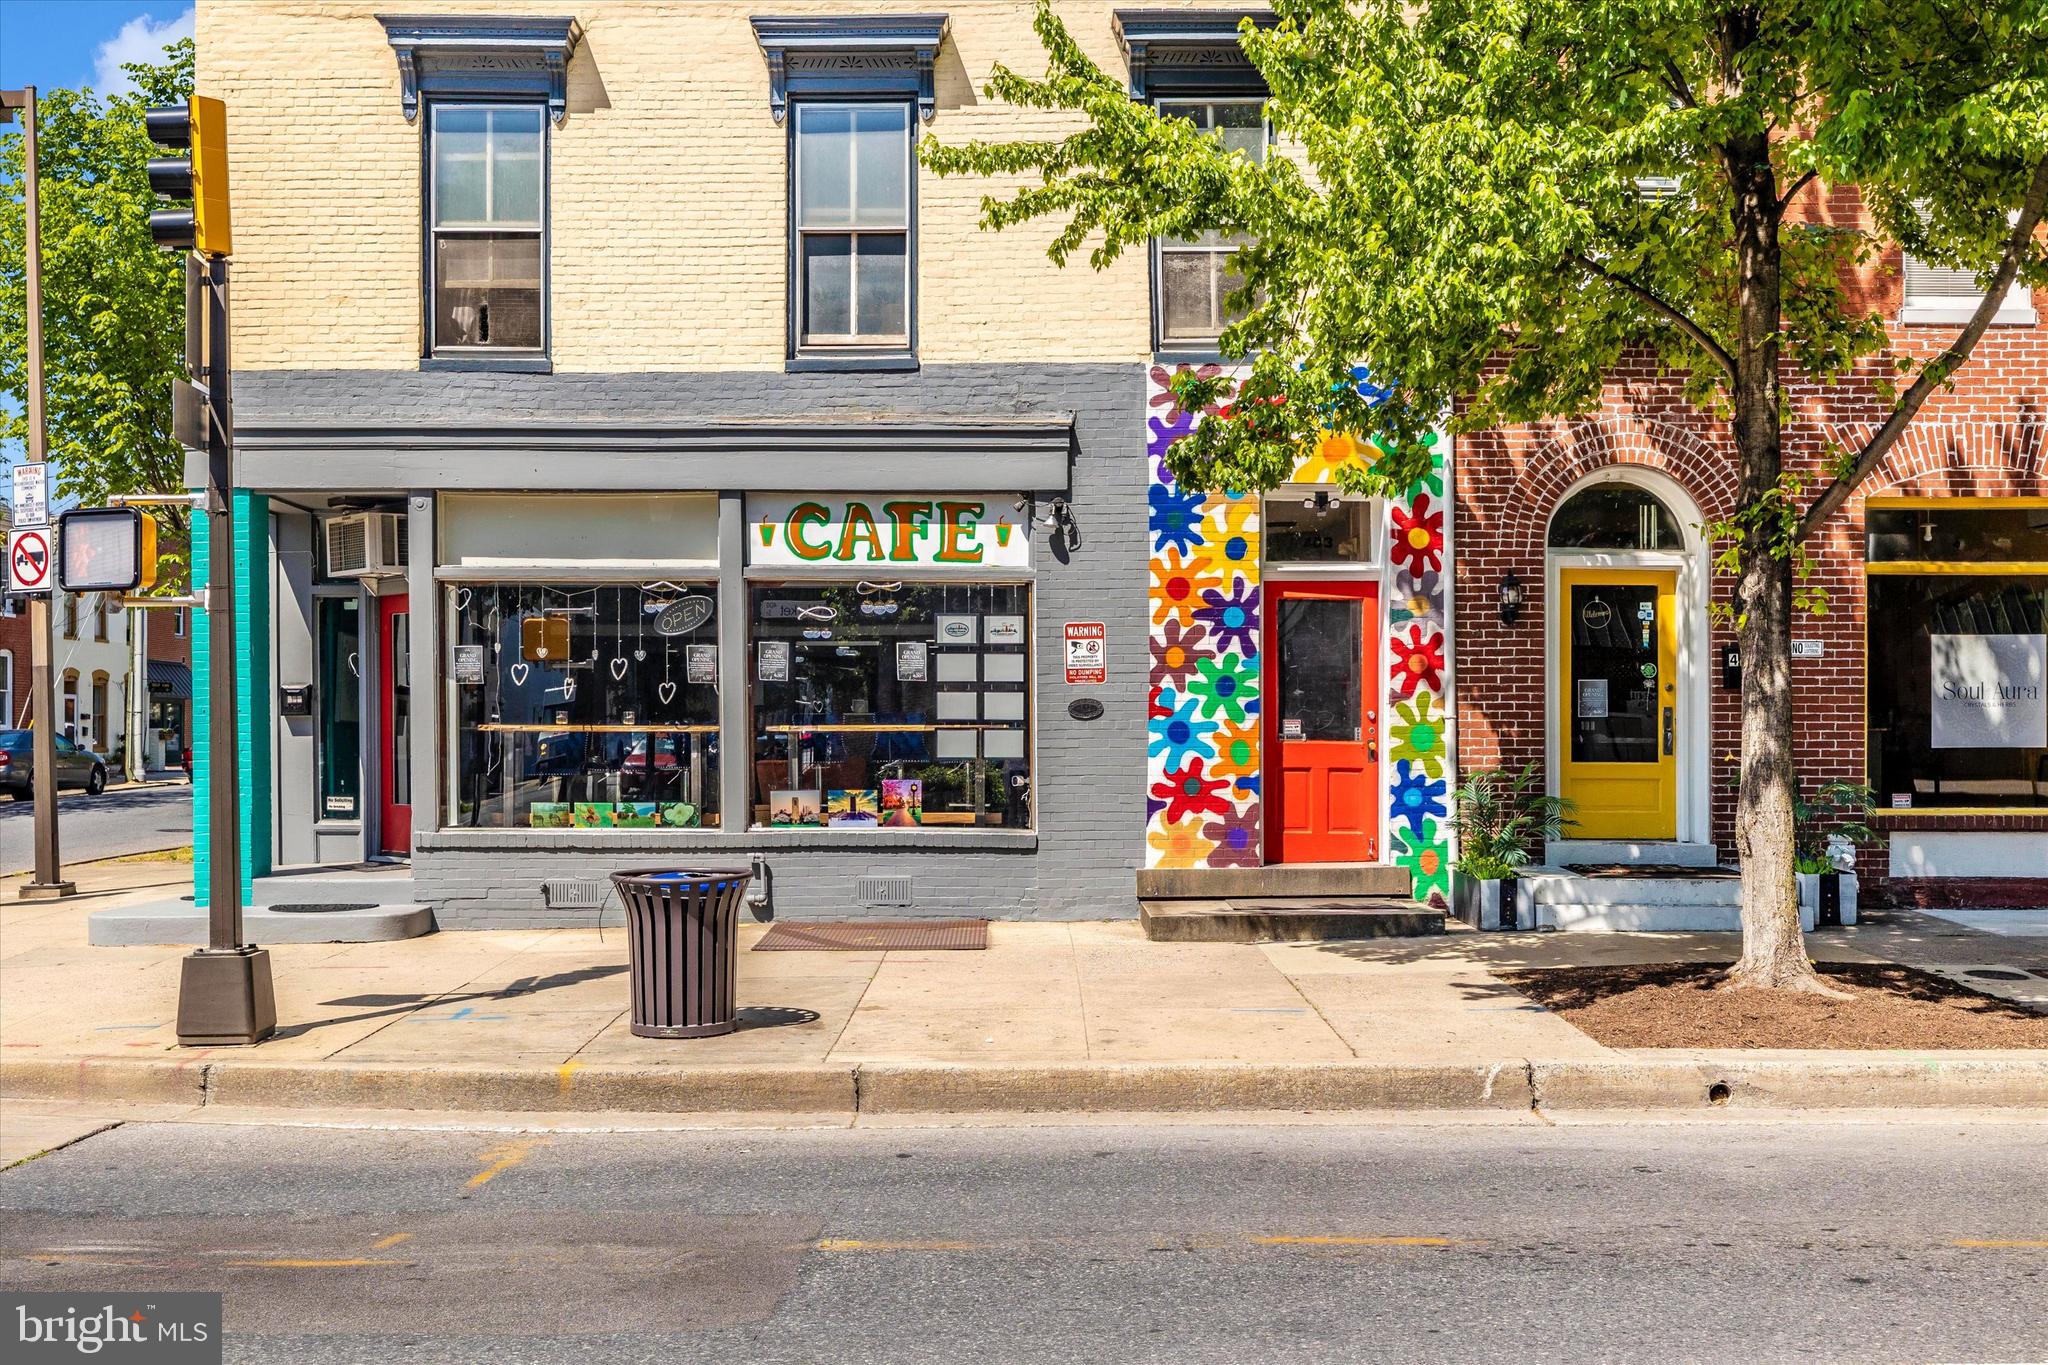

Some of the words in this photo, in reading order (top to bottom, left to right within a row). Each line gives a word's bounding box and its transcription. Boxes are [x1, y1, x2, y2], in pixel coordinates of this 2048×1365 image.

[784, 501, 985, 563] CAFE
[662, 601, 706, 630] OPEN
[1067, 626, 1102, 636] WARNING
[1792, 643, 1803, 654] NO
[1943, 681, 1984, 700] Soul
[1994, 682, 2037, 700] Aura
